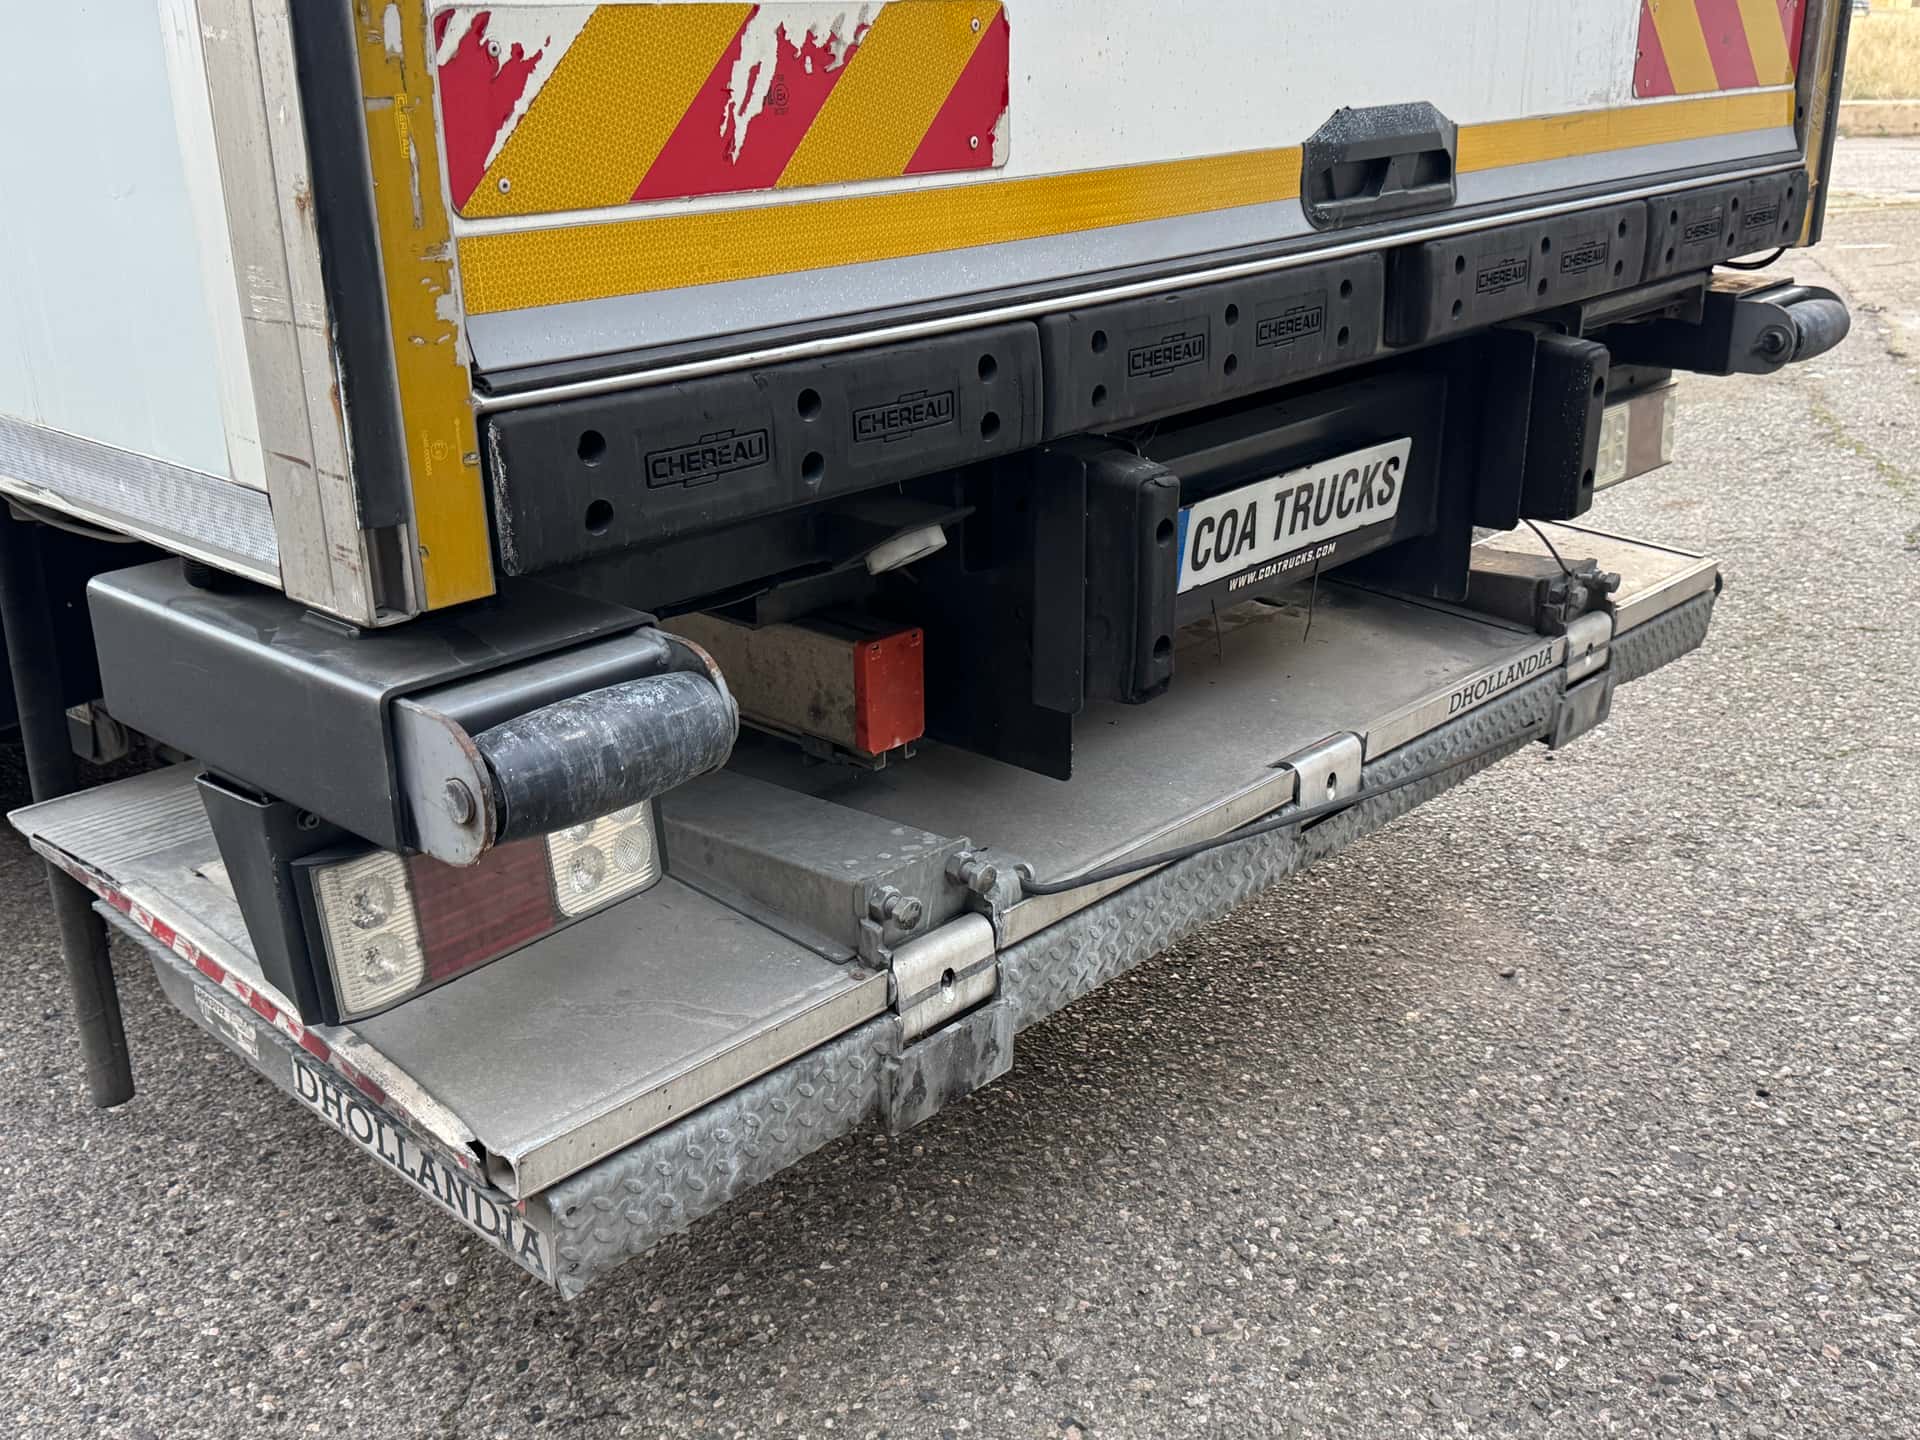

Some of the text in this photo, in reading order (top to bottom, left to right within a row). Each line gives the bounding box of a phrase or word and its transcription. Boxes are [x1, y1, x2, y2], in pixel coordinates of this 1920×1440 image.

[1479, 265, 1526, 288] CHEREAU
[1562, 246, 1605, 269] CHEREAU
[1259, 312, 1321, 340] CHEREAU
[1131, 340, 1201, 370] CHEREAU
[857, 398, 950, 435] CHEREAU
[651, 437, 764, 480] CHEREAU
[1190, 456, 1400, 572] COA TRUCKS
[1229, 542, 1337, 592] WWW.COATRUCKS.COM
[1449, 646, 1553, 715] DHOLLANDIA
[295, 1057, 547, 1275] DHOLLANDIA
